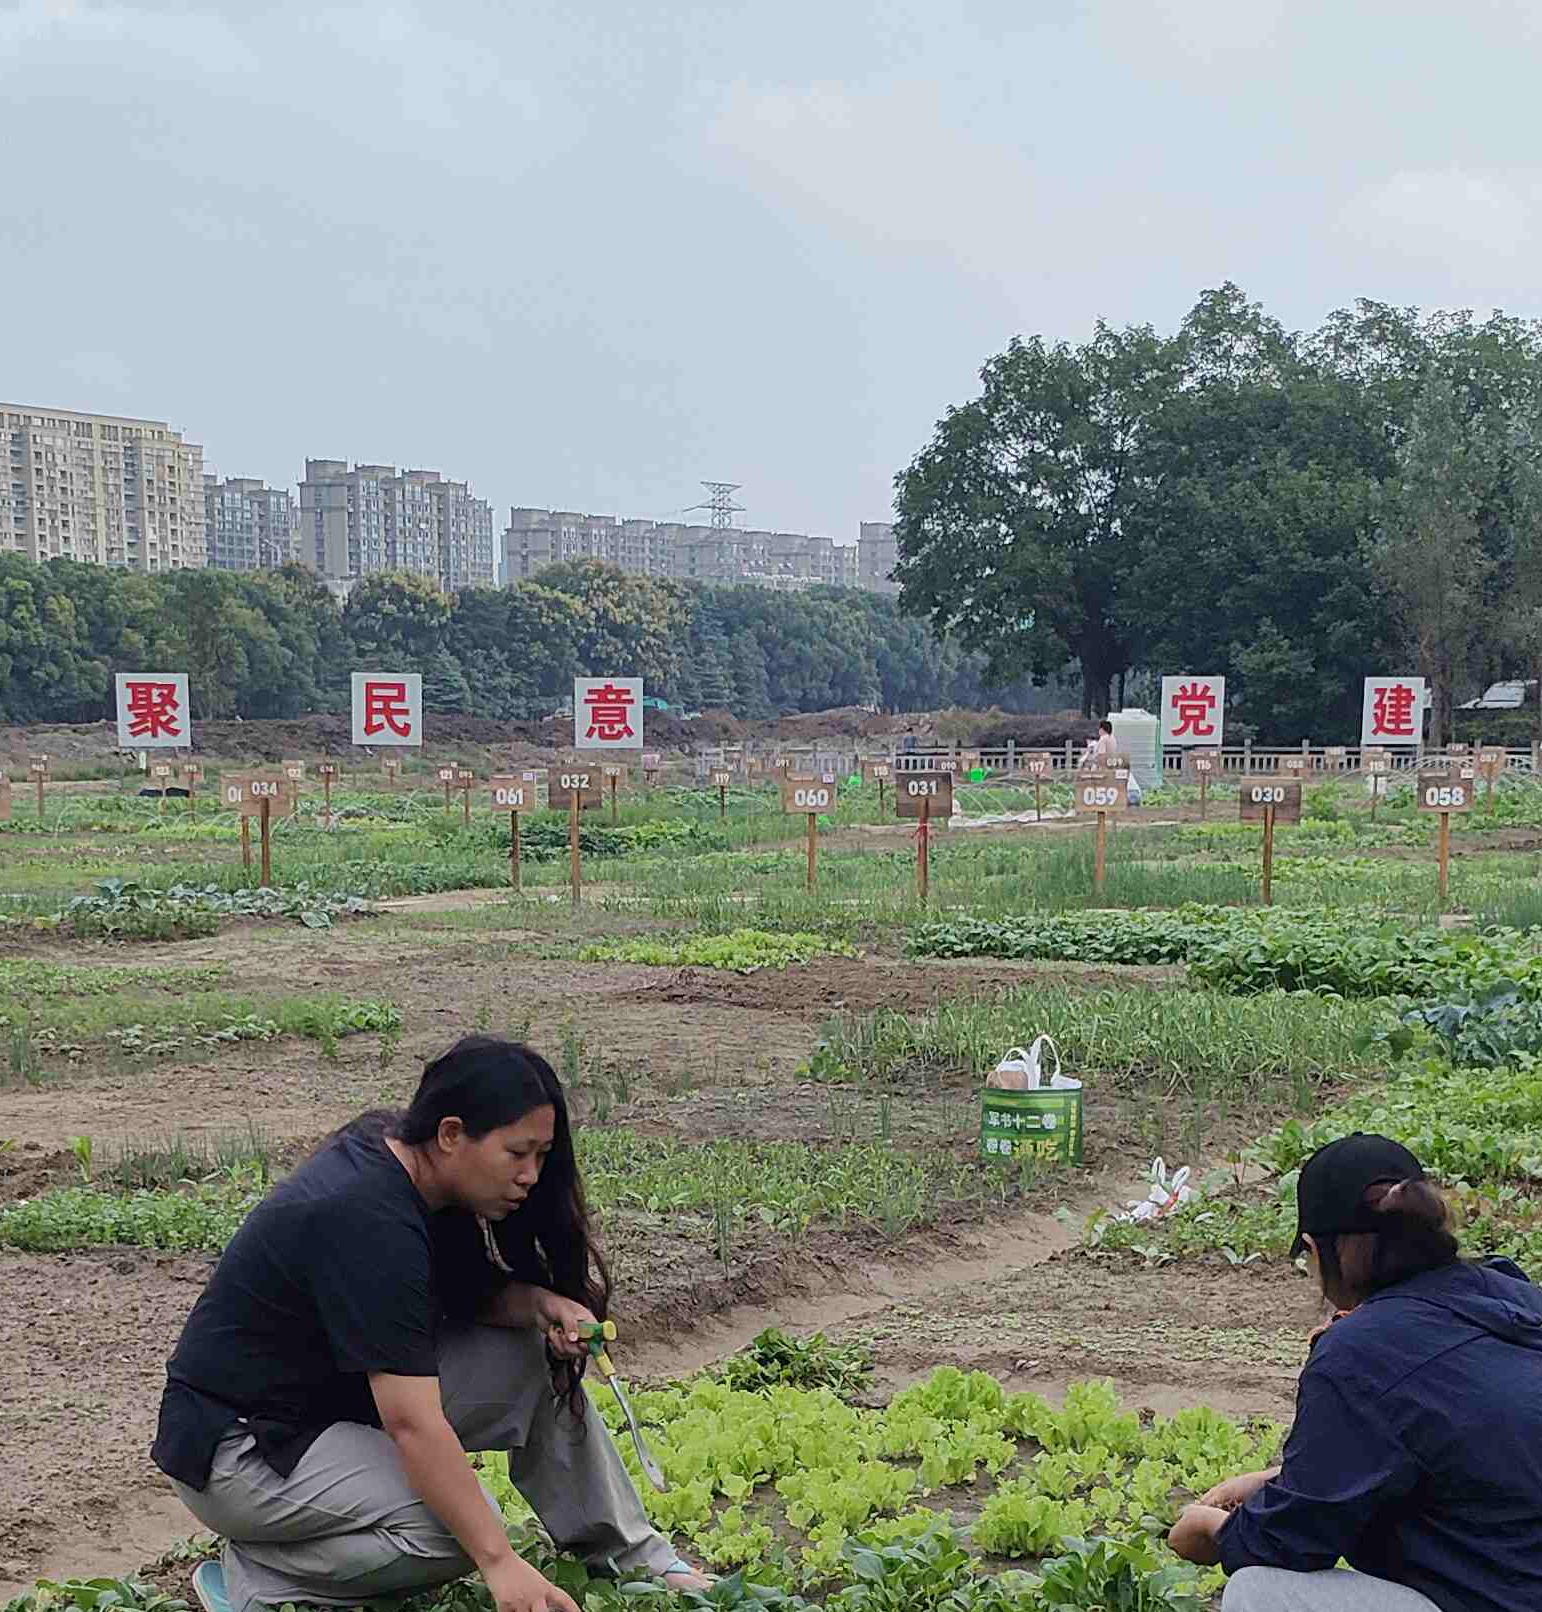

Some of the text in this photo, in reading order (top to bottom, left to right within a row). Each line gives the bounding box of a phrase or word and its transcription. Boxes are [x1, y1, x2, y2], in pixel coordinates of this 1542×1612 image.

[125, 681, 181, 738] 聚
[363, 682, 411, 737] 民
[584, 684, 635, 741] 意
[1171, 683, 1215, 736] 党
[1371, 684, 1416, 736] 建
[250, 781, 277, 796] 034
[560, 774, 590, 789] 032
[907, 780, 938, 796] 031
[495, 787, 524, 805] 061
[794, 789, 829, 807] 060
[1083, 787, 1119, 805] 059
[1251, 786, 1285, 802] 030
[1424, 787, 1465, 807] 058
